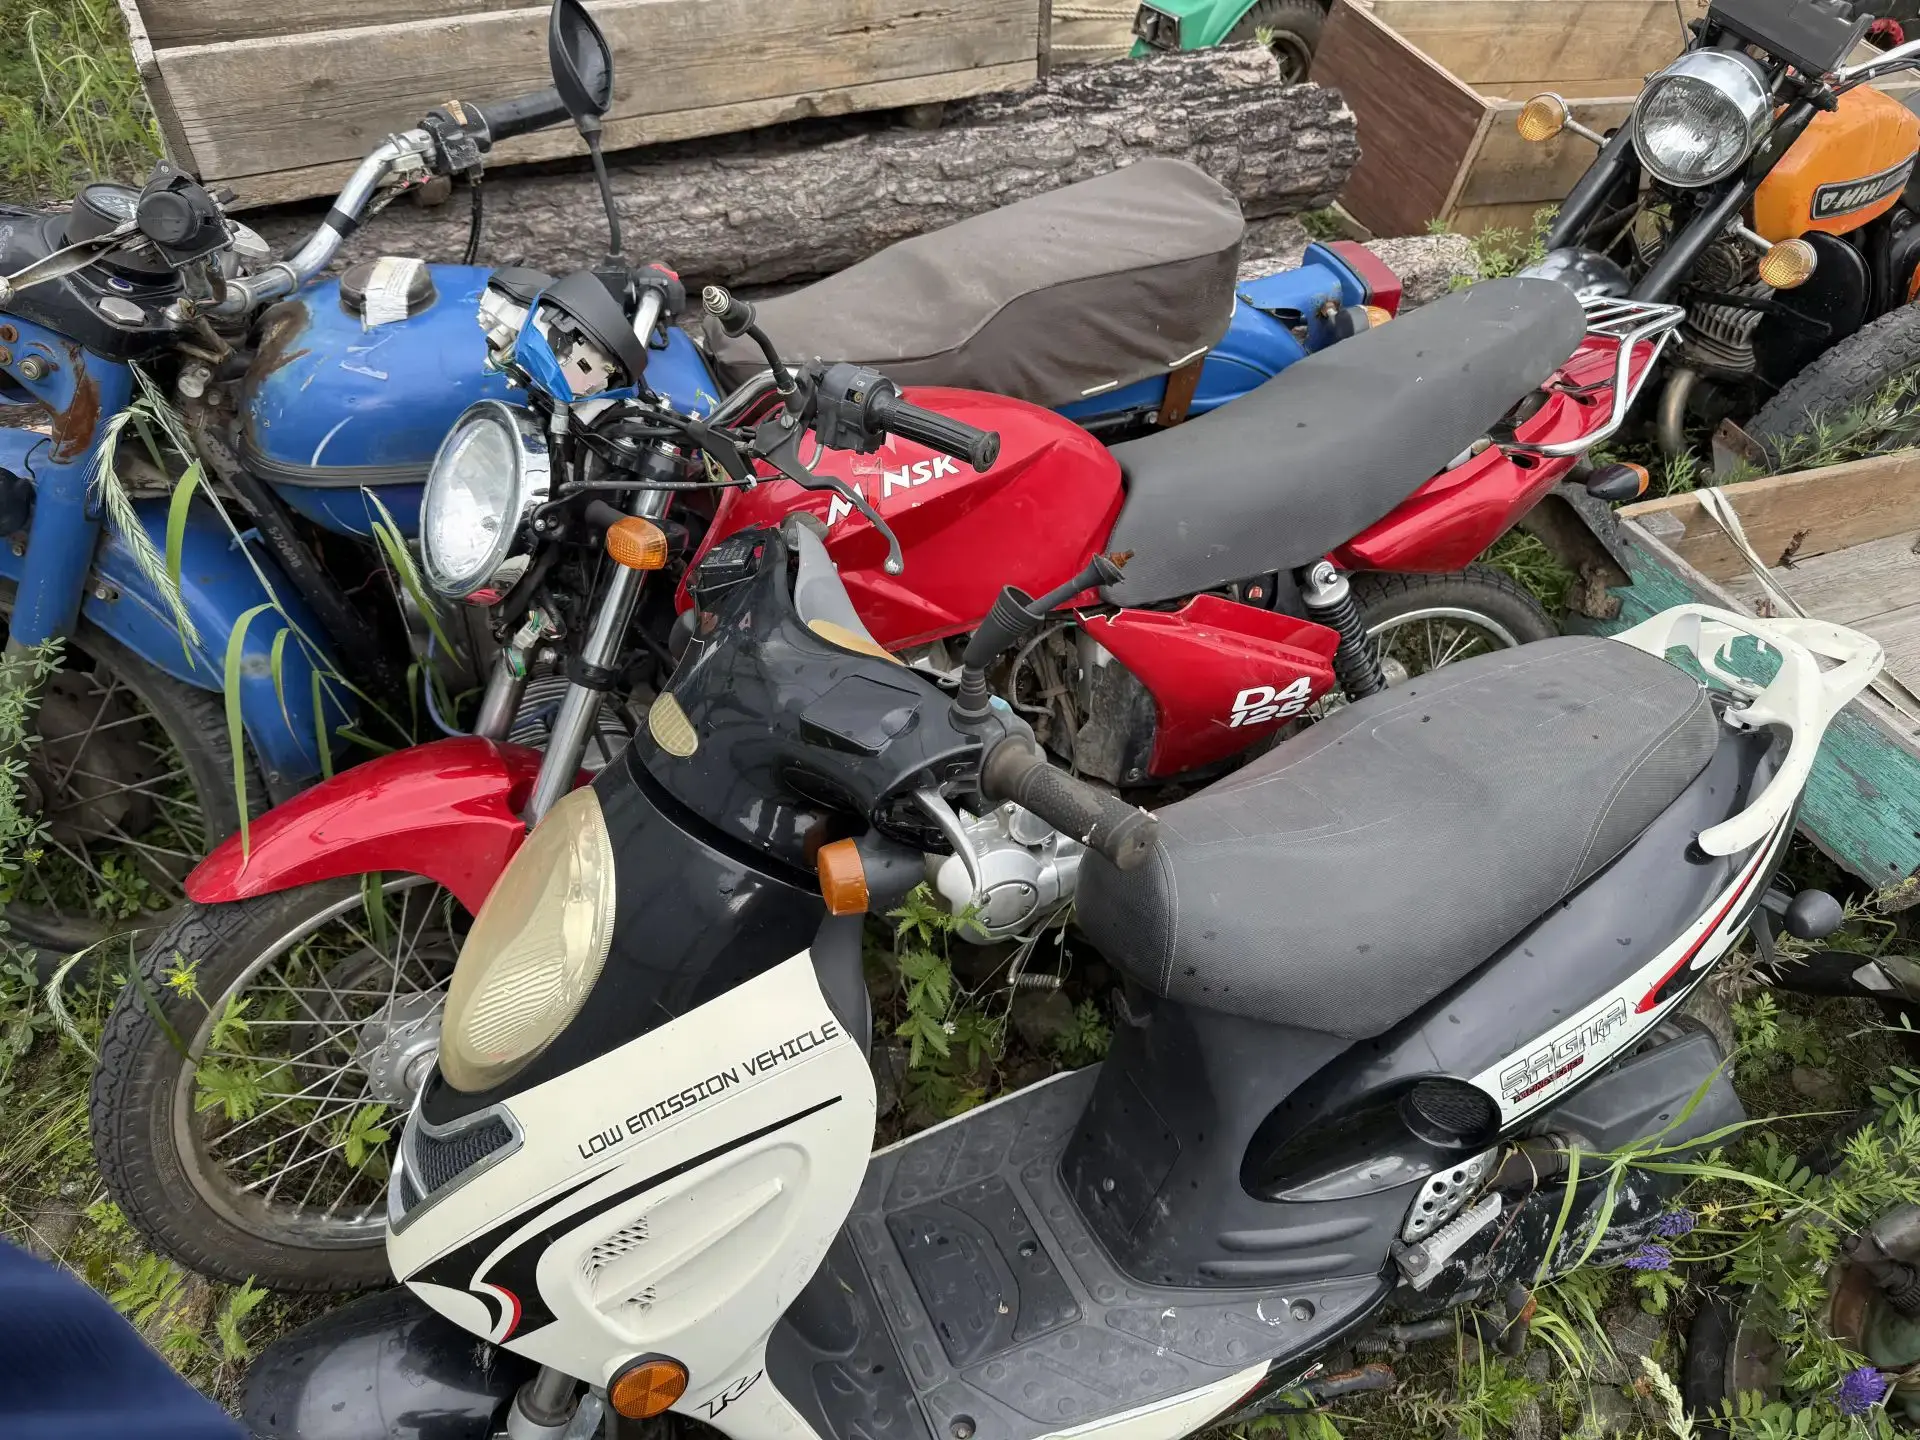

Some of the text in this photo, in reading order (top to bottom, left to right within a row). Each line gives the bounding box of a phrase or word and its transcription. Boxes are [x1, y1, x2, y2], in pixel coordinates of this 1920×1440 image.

[826, 454, 960, 527] MNSK
[1229, 696, 1310, 728] 125
[1231, 676, 1312, 713] D4
[578, 1020, 840, 1159] LOW EMISSION VEHICLE
